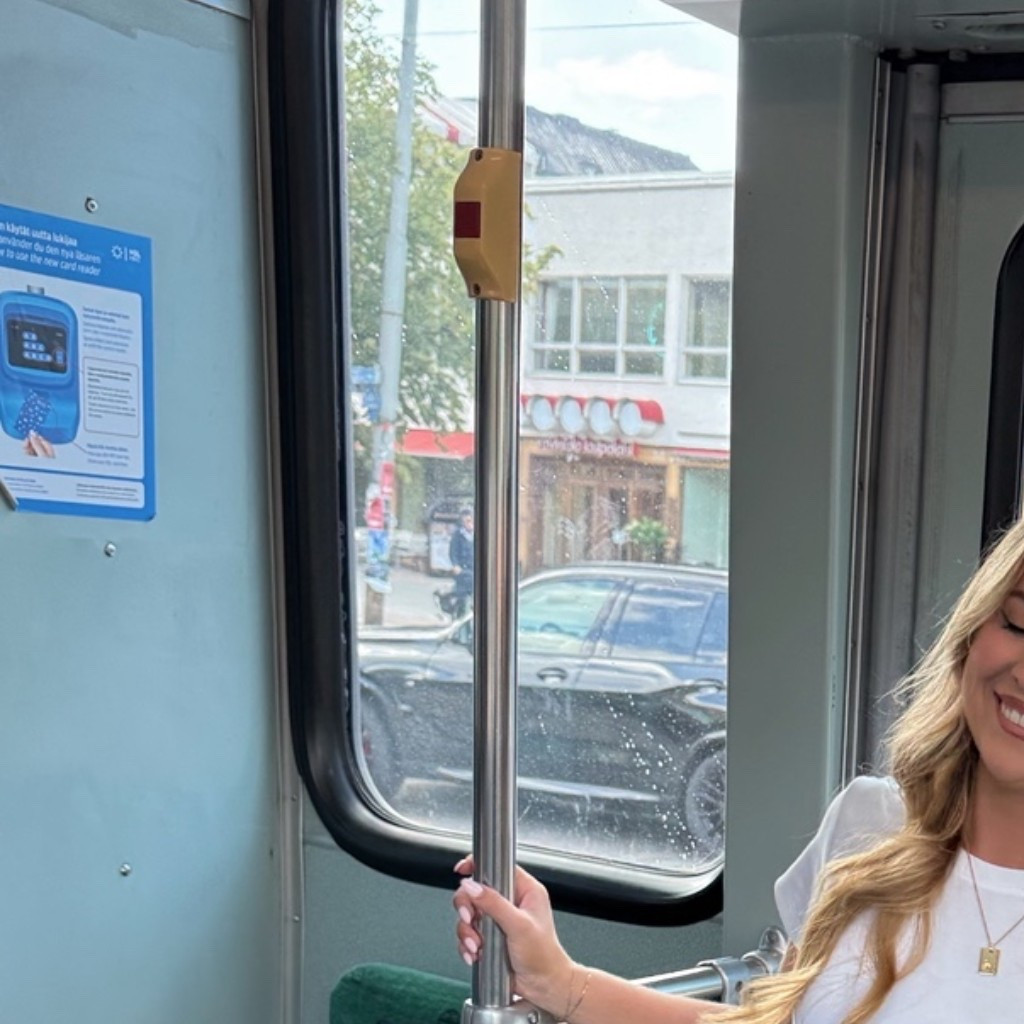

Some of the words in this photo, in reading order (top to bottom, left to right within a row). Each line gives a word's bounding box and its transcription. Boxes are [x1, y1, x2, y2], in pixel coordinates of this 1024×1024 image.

[31, 229, 51, 241] uutta
[52, 232, 77, 247] lukijaa
[34, 242, 44, 252] du
[45, 245, 60, 255] den
[15, 251, 29, 261] use
[30, 253, 43, 264] the
[43, 257, 59, 268] new
[60, 260, 77, 271] card
[77, 264, 101, 275] reader
